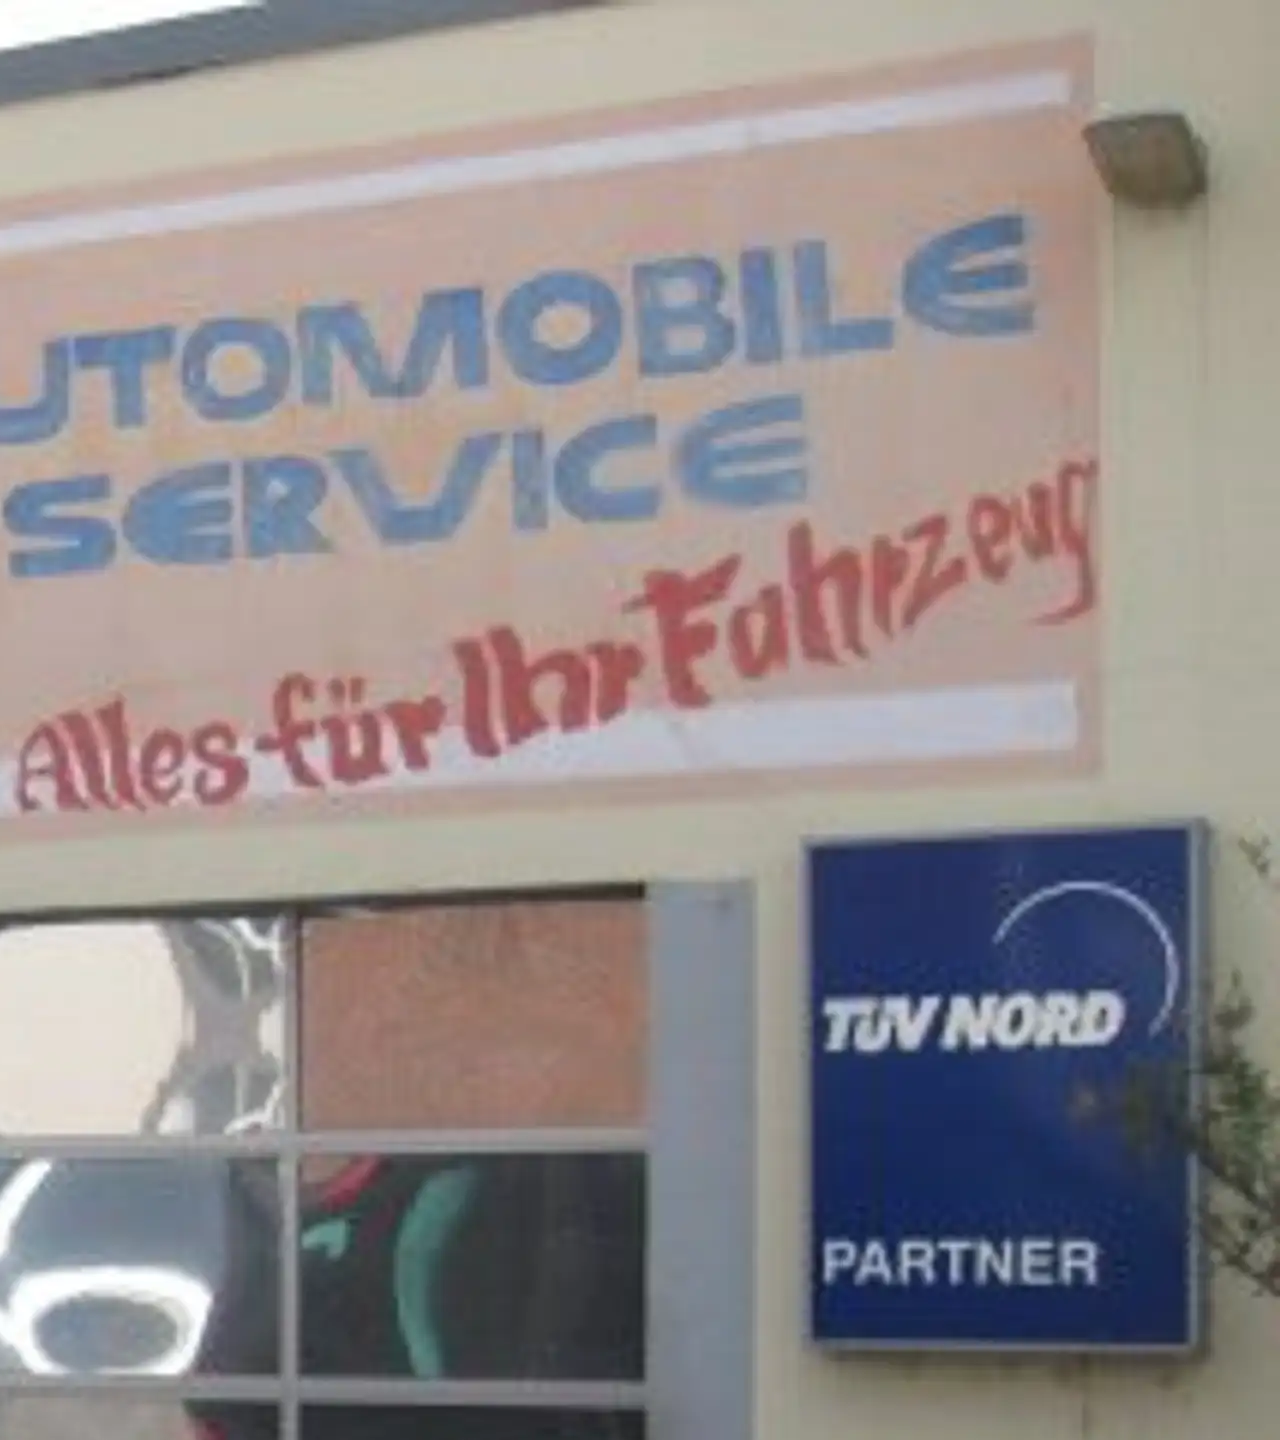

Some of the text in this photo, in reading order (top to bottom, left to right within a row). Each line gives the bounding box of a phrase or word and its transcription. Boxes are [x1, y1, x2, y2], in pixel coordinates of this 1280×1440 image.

[0, 393, 812, 580] SERVICE
[13, 457, 1100, 813] Alles für Ihr Fahrzeug
[940, 990, 1127, 1050] NORD
[821, 1239, 1100, 1286] PARTNER
